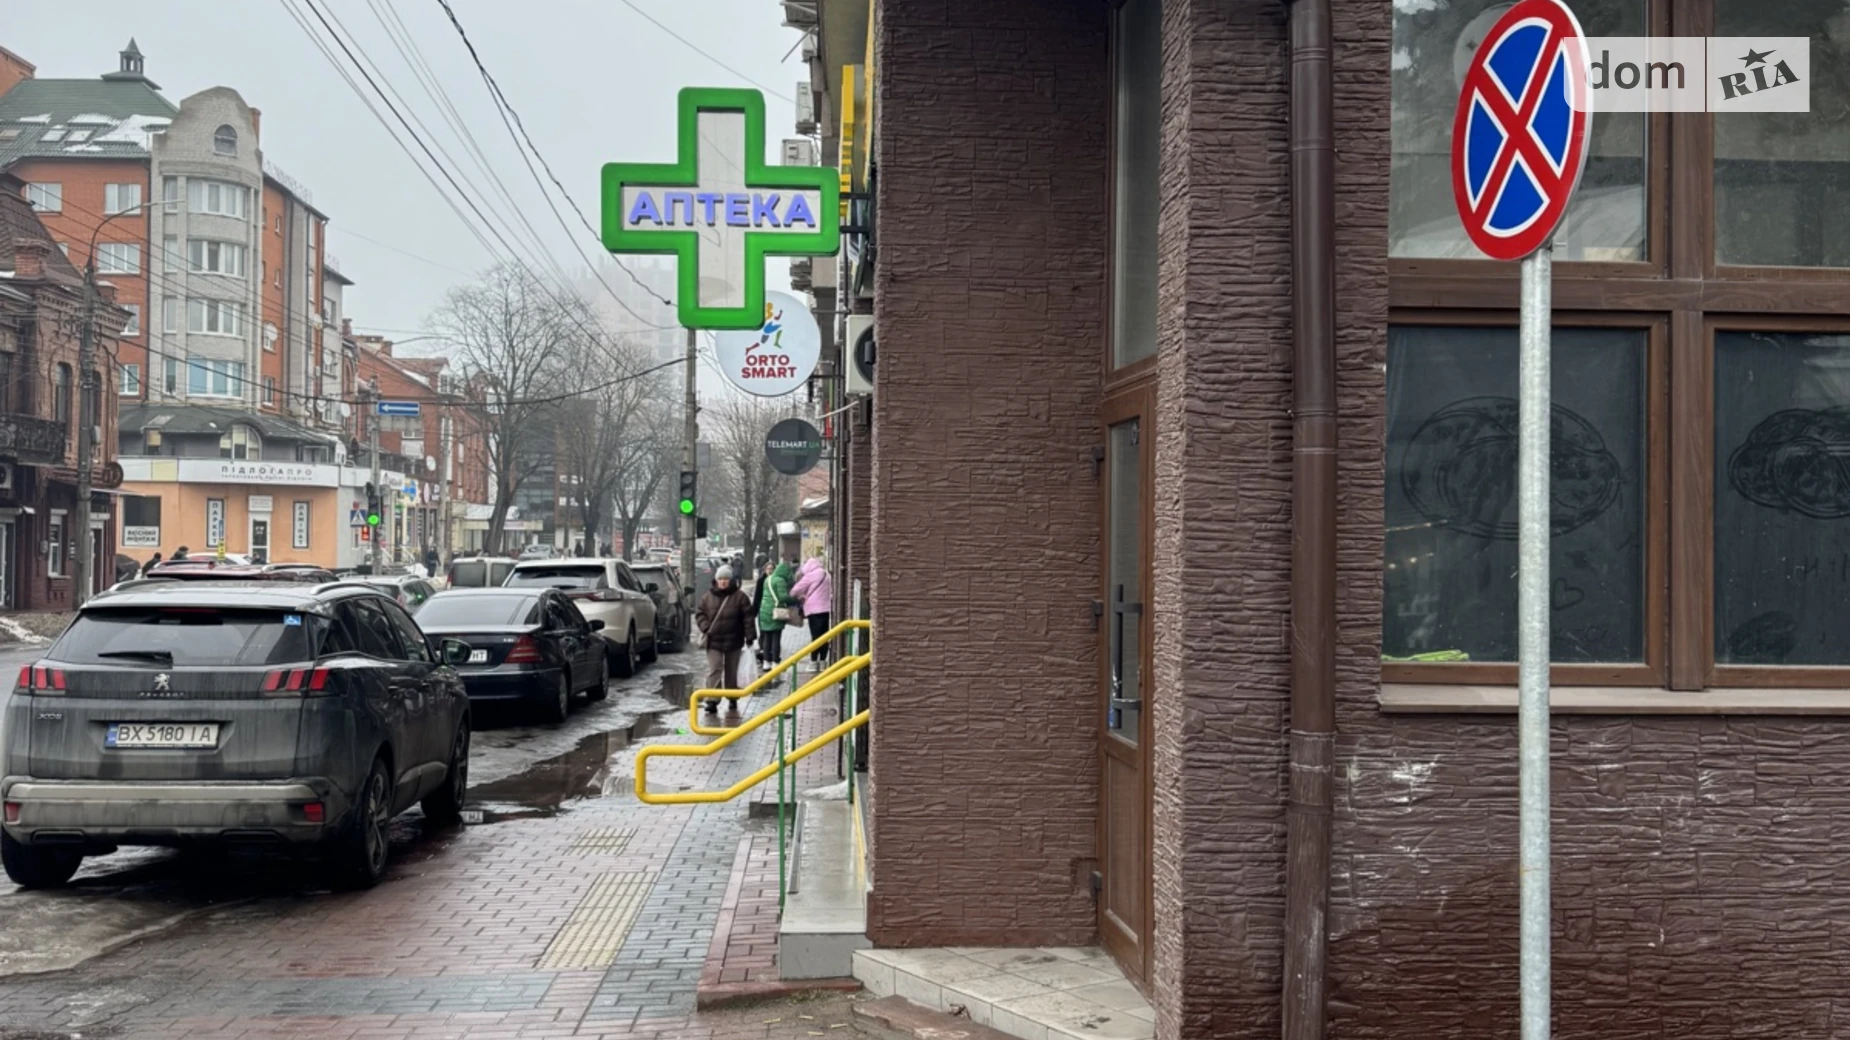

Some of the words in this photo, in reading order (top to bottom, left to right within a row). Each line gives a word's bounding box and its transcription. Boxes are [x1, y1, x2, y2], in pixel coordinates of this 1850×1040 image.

[629, 191, 817, 228] АПТЕКА
[746, 354, 790, 366] ORTO
[741, 366, 797, 379] SMART
[117, 725, 145, 742] BX
[146, 725, 184, 742] 5180
